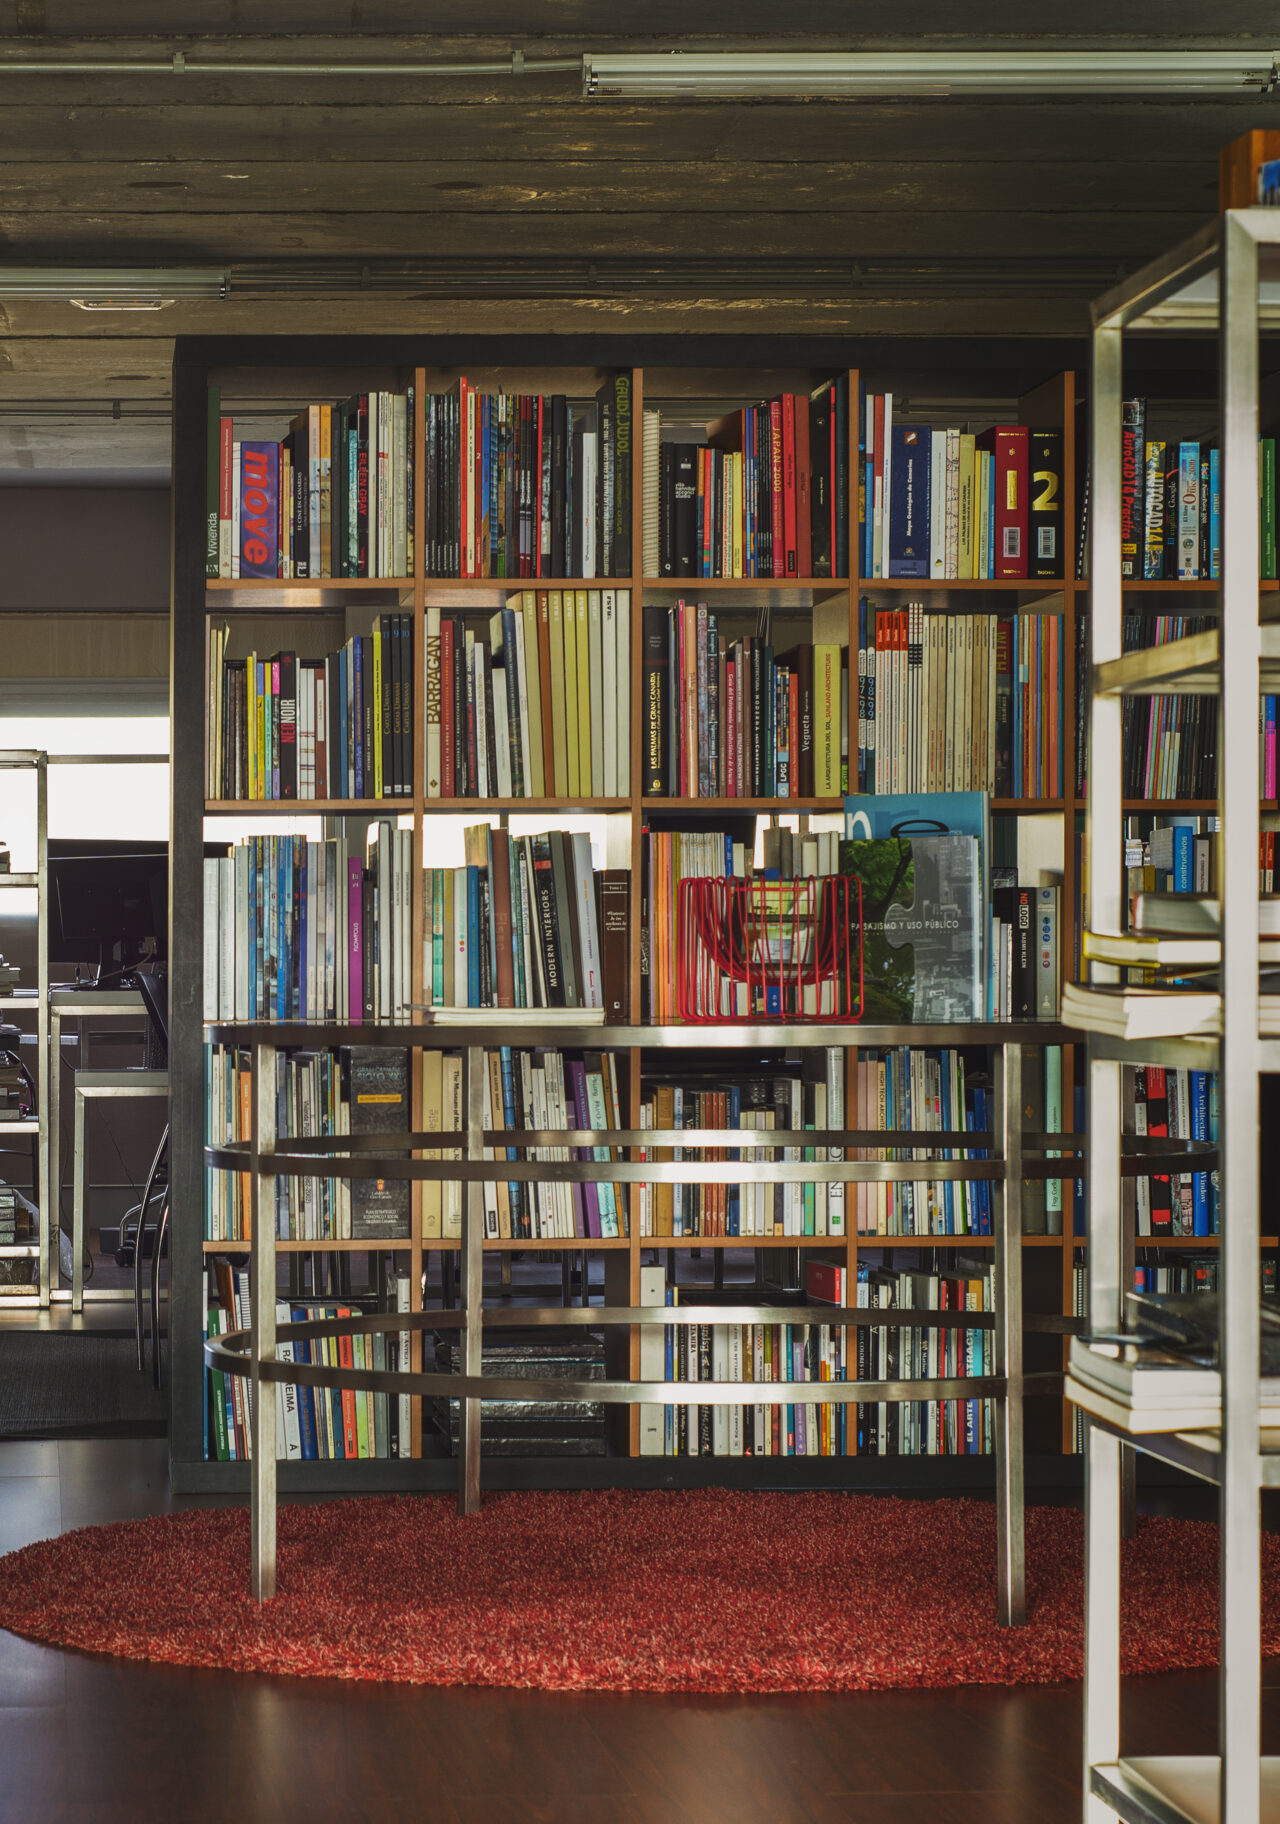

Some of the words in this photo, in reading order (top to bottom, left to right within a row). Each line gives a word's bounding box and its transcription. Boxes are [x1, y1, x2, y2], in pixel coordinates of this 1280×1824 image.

[773, 426, 781, 464] JAPAN
[1122, 430, 1136, 478] AutoCAD
[773, 466, 781, 492] 2000
[1032, 470, 1060, 511] 2
[1168, 480, 1177, 508] Google
[243, 450, 269, 565] move
[358, 488, 367, 516] GRAY
[1145, 470, 1163, 528] AUTOCAD
[207, 512, 218, 558] Vivienda
[996, 632, 1008, 671] WITH
[393, 710, 401, 734] CARTAS
[801, 715, 811, 752] Vegueta
[1180, 836, 1189, 889] constructivos
[540, 889, 554, 941] INTERIORS
[1018, 892, 1028, 905] NO
[1019, 905, 1028, 928] LOGO
[851, 921, 896, 931] PASAJISMO
[899, 920, 904, 929] Y
[906, 920, 922, 929] USO
[924, 918, 958, 929] PÚBLICO
[545, 944, 558, 988] MODERN
[1198, 1077, 1207, 1092] The
[966, 1402, 974, 1428] ARTE
[966, 1430, 974, 1442] EL
